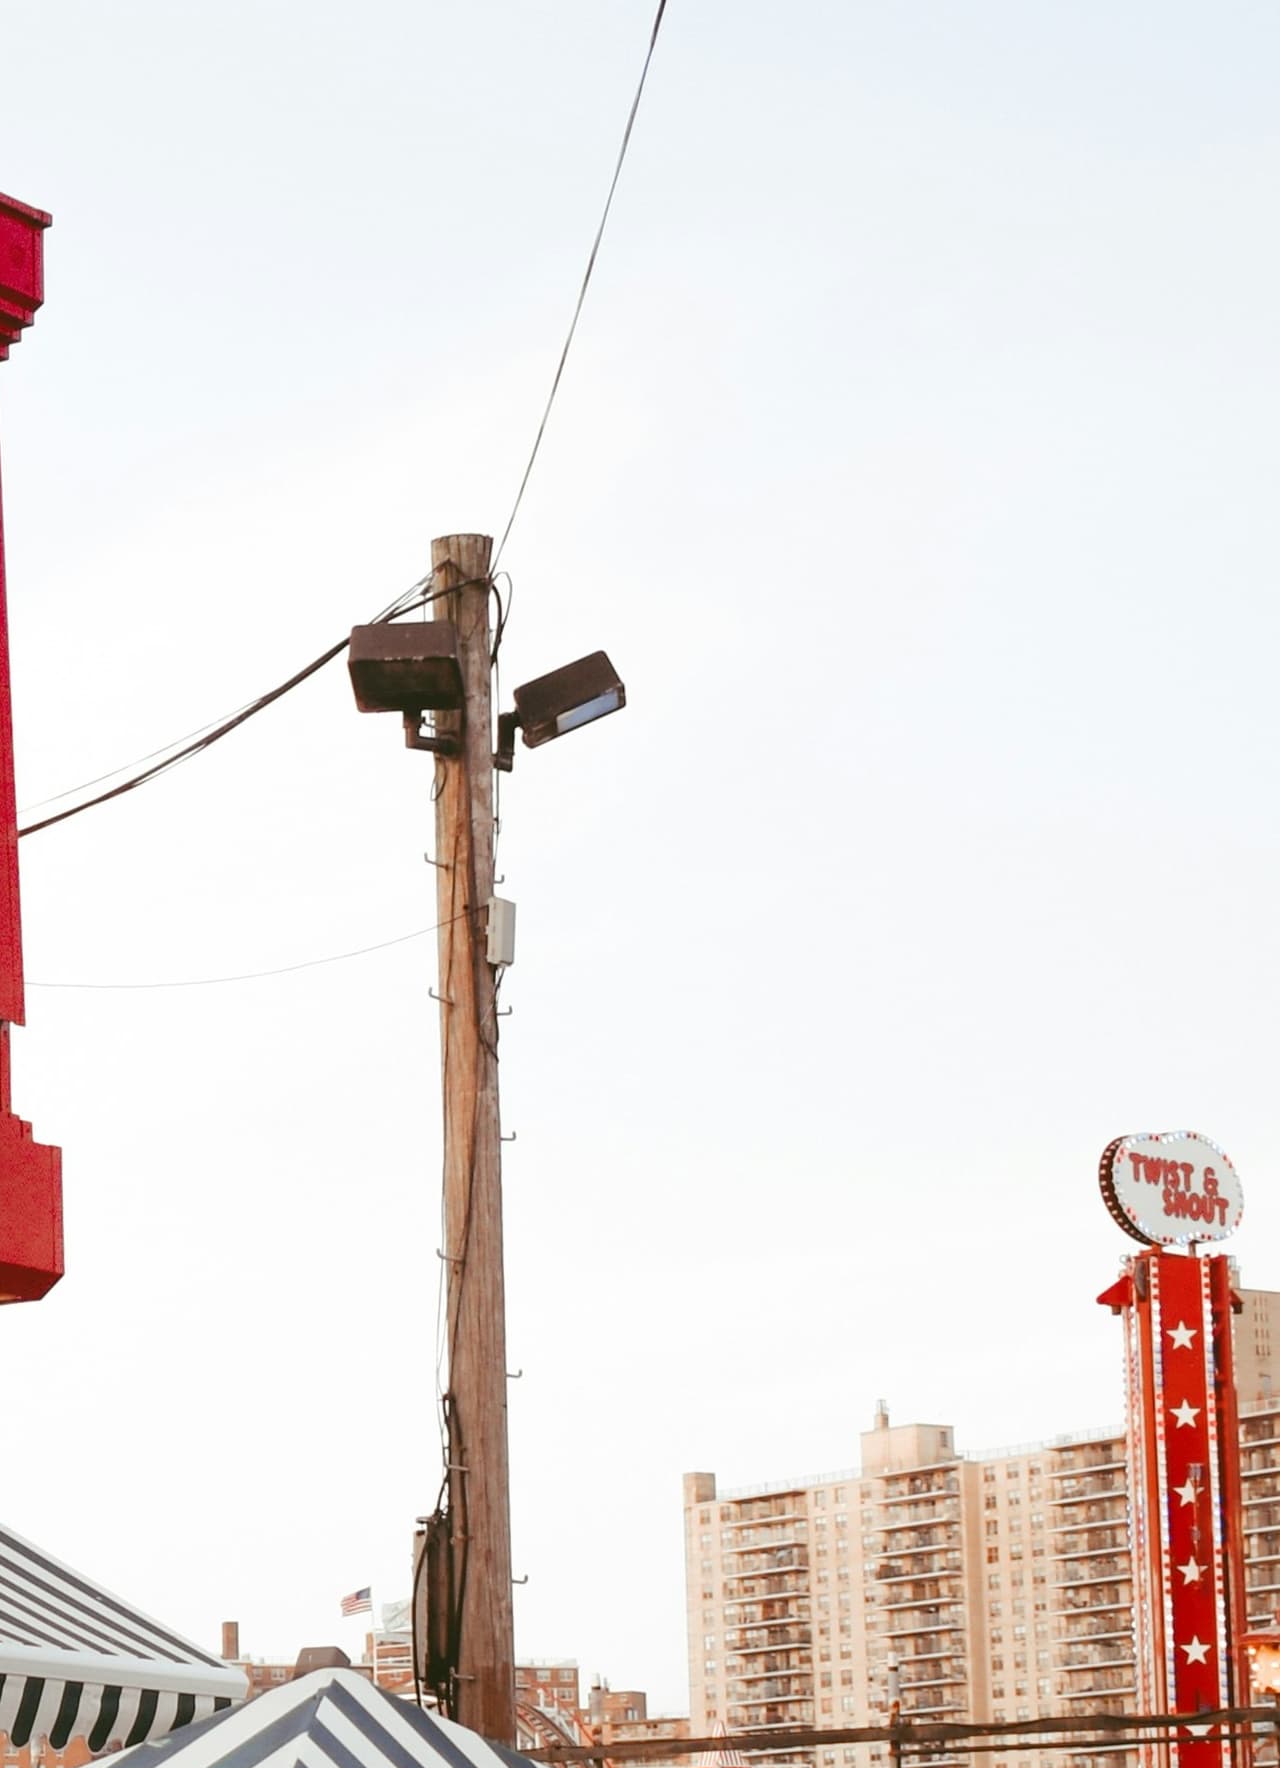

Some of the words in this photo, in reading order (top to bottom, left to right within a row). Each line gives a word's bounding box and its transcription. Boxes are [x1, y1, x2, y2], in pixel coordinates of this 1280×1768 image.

[1128, 1152, 1194, 1193] TWIST
[1203, 1167, 1218, 1196] &
[1162, 1189, 1229, 1227] SHOUT
